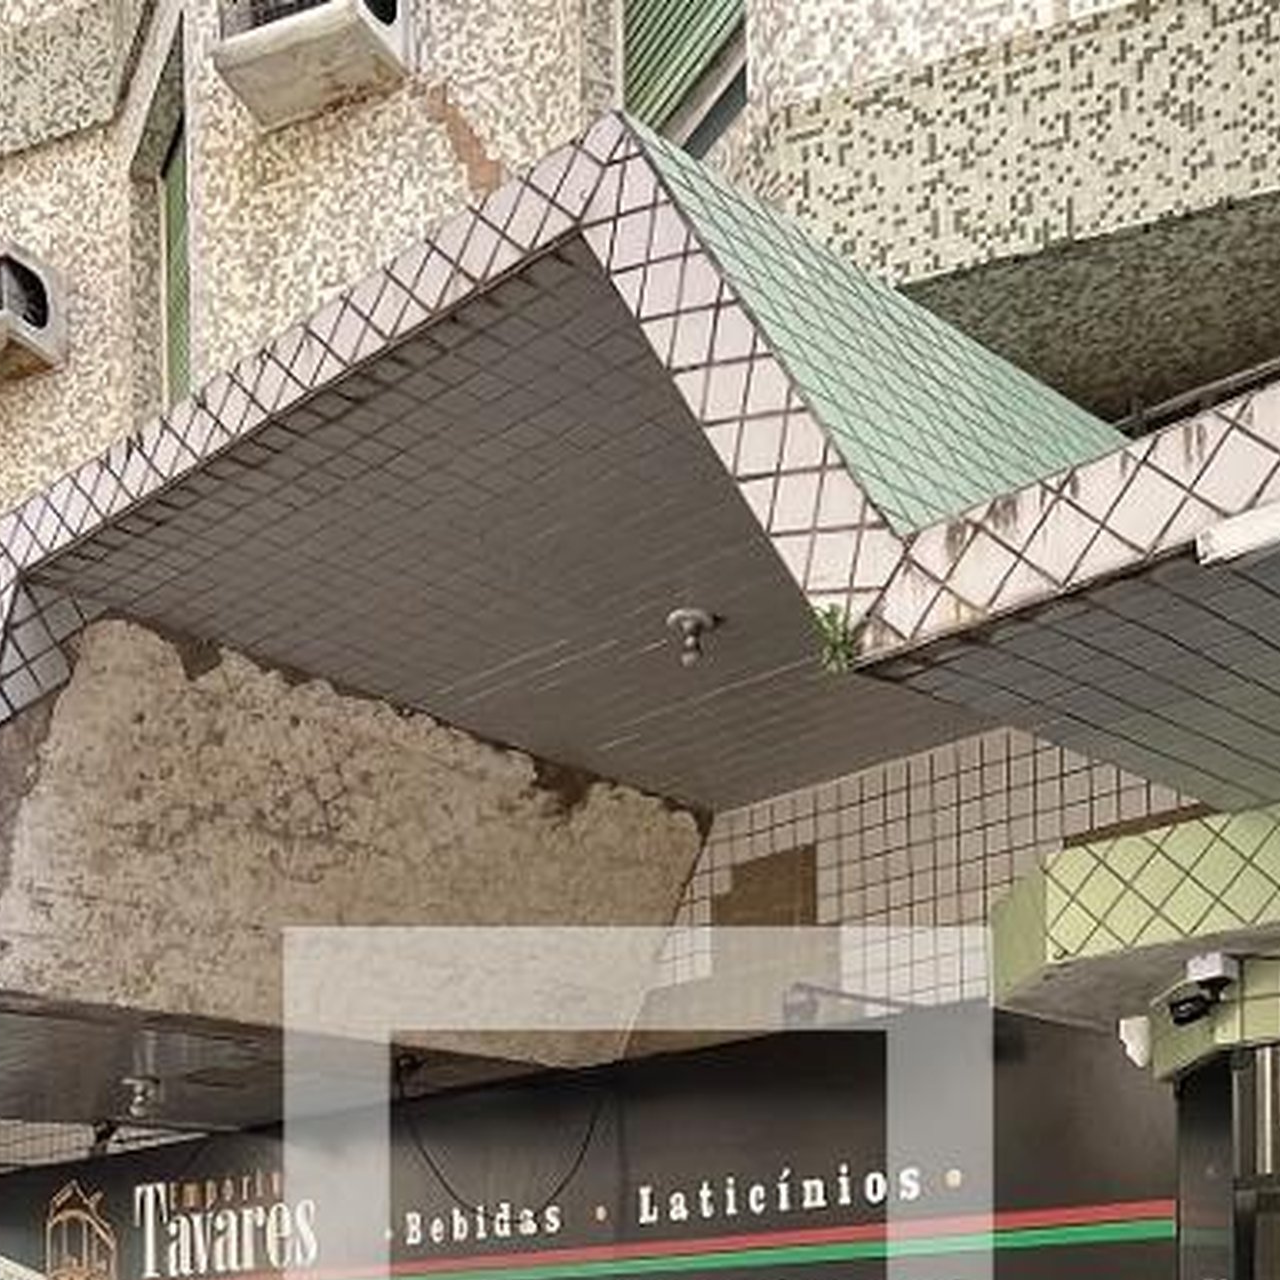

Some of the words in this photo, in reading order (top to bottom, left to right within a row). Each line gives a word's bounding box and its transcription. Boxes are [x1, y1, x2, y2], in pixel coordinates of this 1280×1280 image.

[134, 1182, 318, 1279] Tavares
[405, 1202, 561, 1245] Bebidas
[638, 1162, 921, 1225] Laticínios
